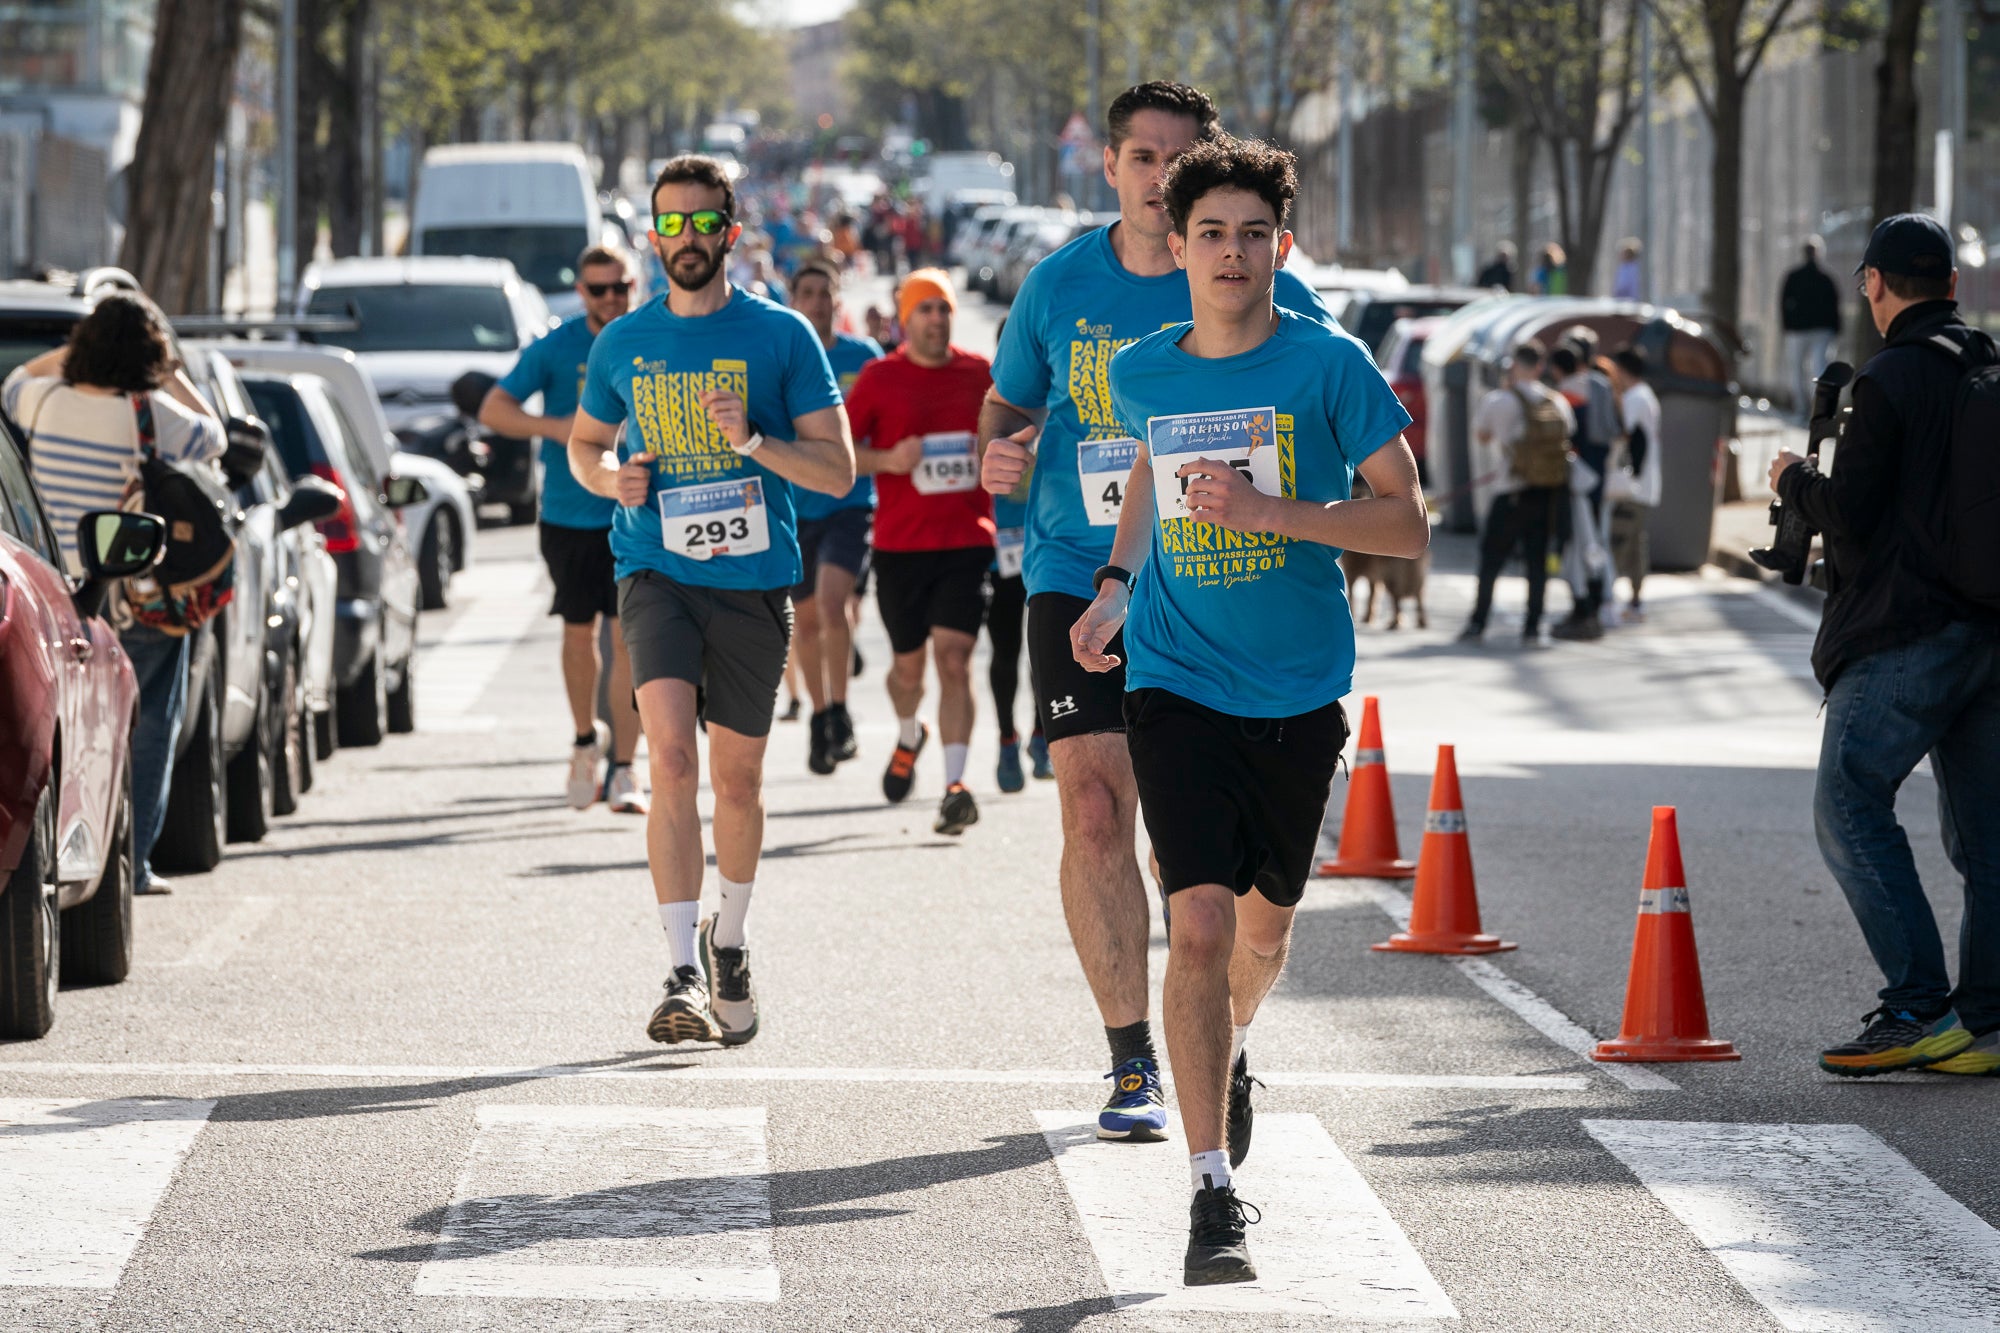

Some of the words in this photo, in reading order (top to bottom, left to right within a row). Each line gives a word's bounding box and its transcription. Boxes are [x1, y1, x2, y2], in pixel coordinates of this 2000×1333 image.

[1079, 323, 1112, 335] avan
[632, 372, 747, 392] PARKINSON
[1171, 420, 1250, 436] PARKINSON
[1174, 459, 1254, 495] 15
[1102, 481, 1128, 506] 4
[685, 517, 749, 547] 293
[1162, 521, 1303, 554] PARKINSO
[1175, 554, 1286, 577] PARKINSON
[1186, 554, 1212, 563] CURSA
[1213, 553, 1217, 561] I
[1219, 548, 1269, 560] PASSEJADA
[1270, 546, 1285, 555] PEL
